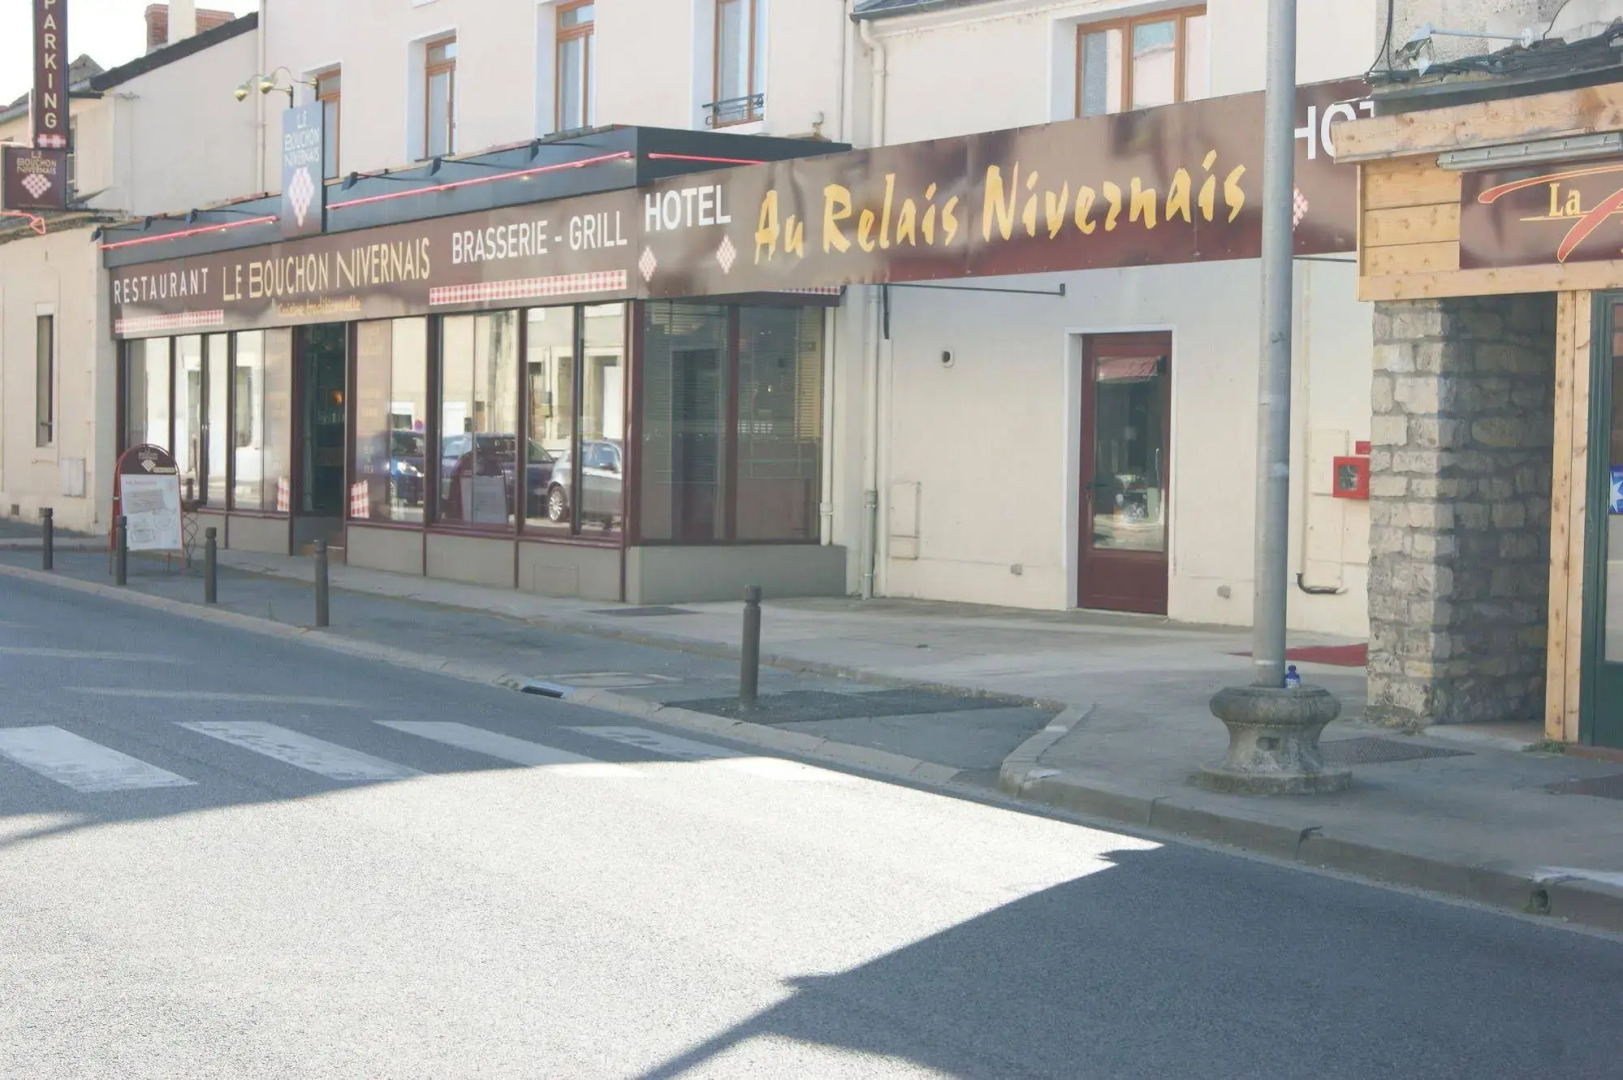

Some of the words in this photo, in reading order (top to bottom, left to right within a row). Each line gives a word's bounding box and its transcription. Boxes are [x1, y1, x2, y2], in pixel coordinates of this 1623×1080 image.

[43, 0, 58, 129] PARKING
[16, 157, 57, 168] BOUCHON
[16, 165, 57, 175] NIVERNAIS
[644, 184, 731, 232] HOTEL
[754, 189, 804, 265] Au
[823, 172, 959, 253] Relais
[982, 149, 1247, 242] Nivernais
[1548, 182, 1581, 217] La
[452, 220, 548, 265] BRASSERIE
[569, 211, 628, 251] GRILL
[114, 267, 209, 304] RESTAURANT
[223, 264, 242, 301] LE
[249, 252, 329, 299] BOUCHON
[336, 237, 431, 289] NIVERNAIS
